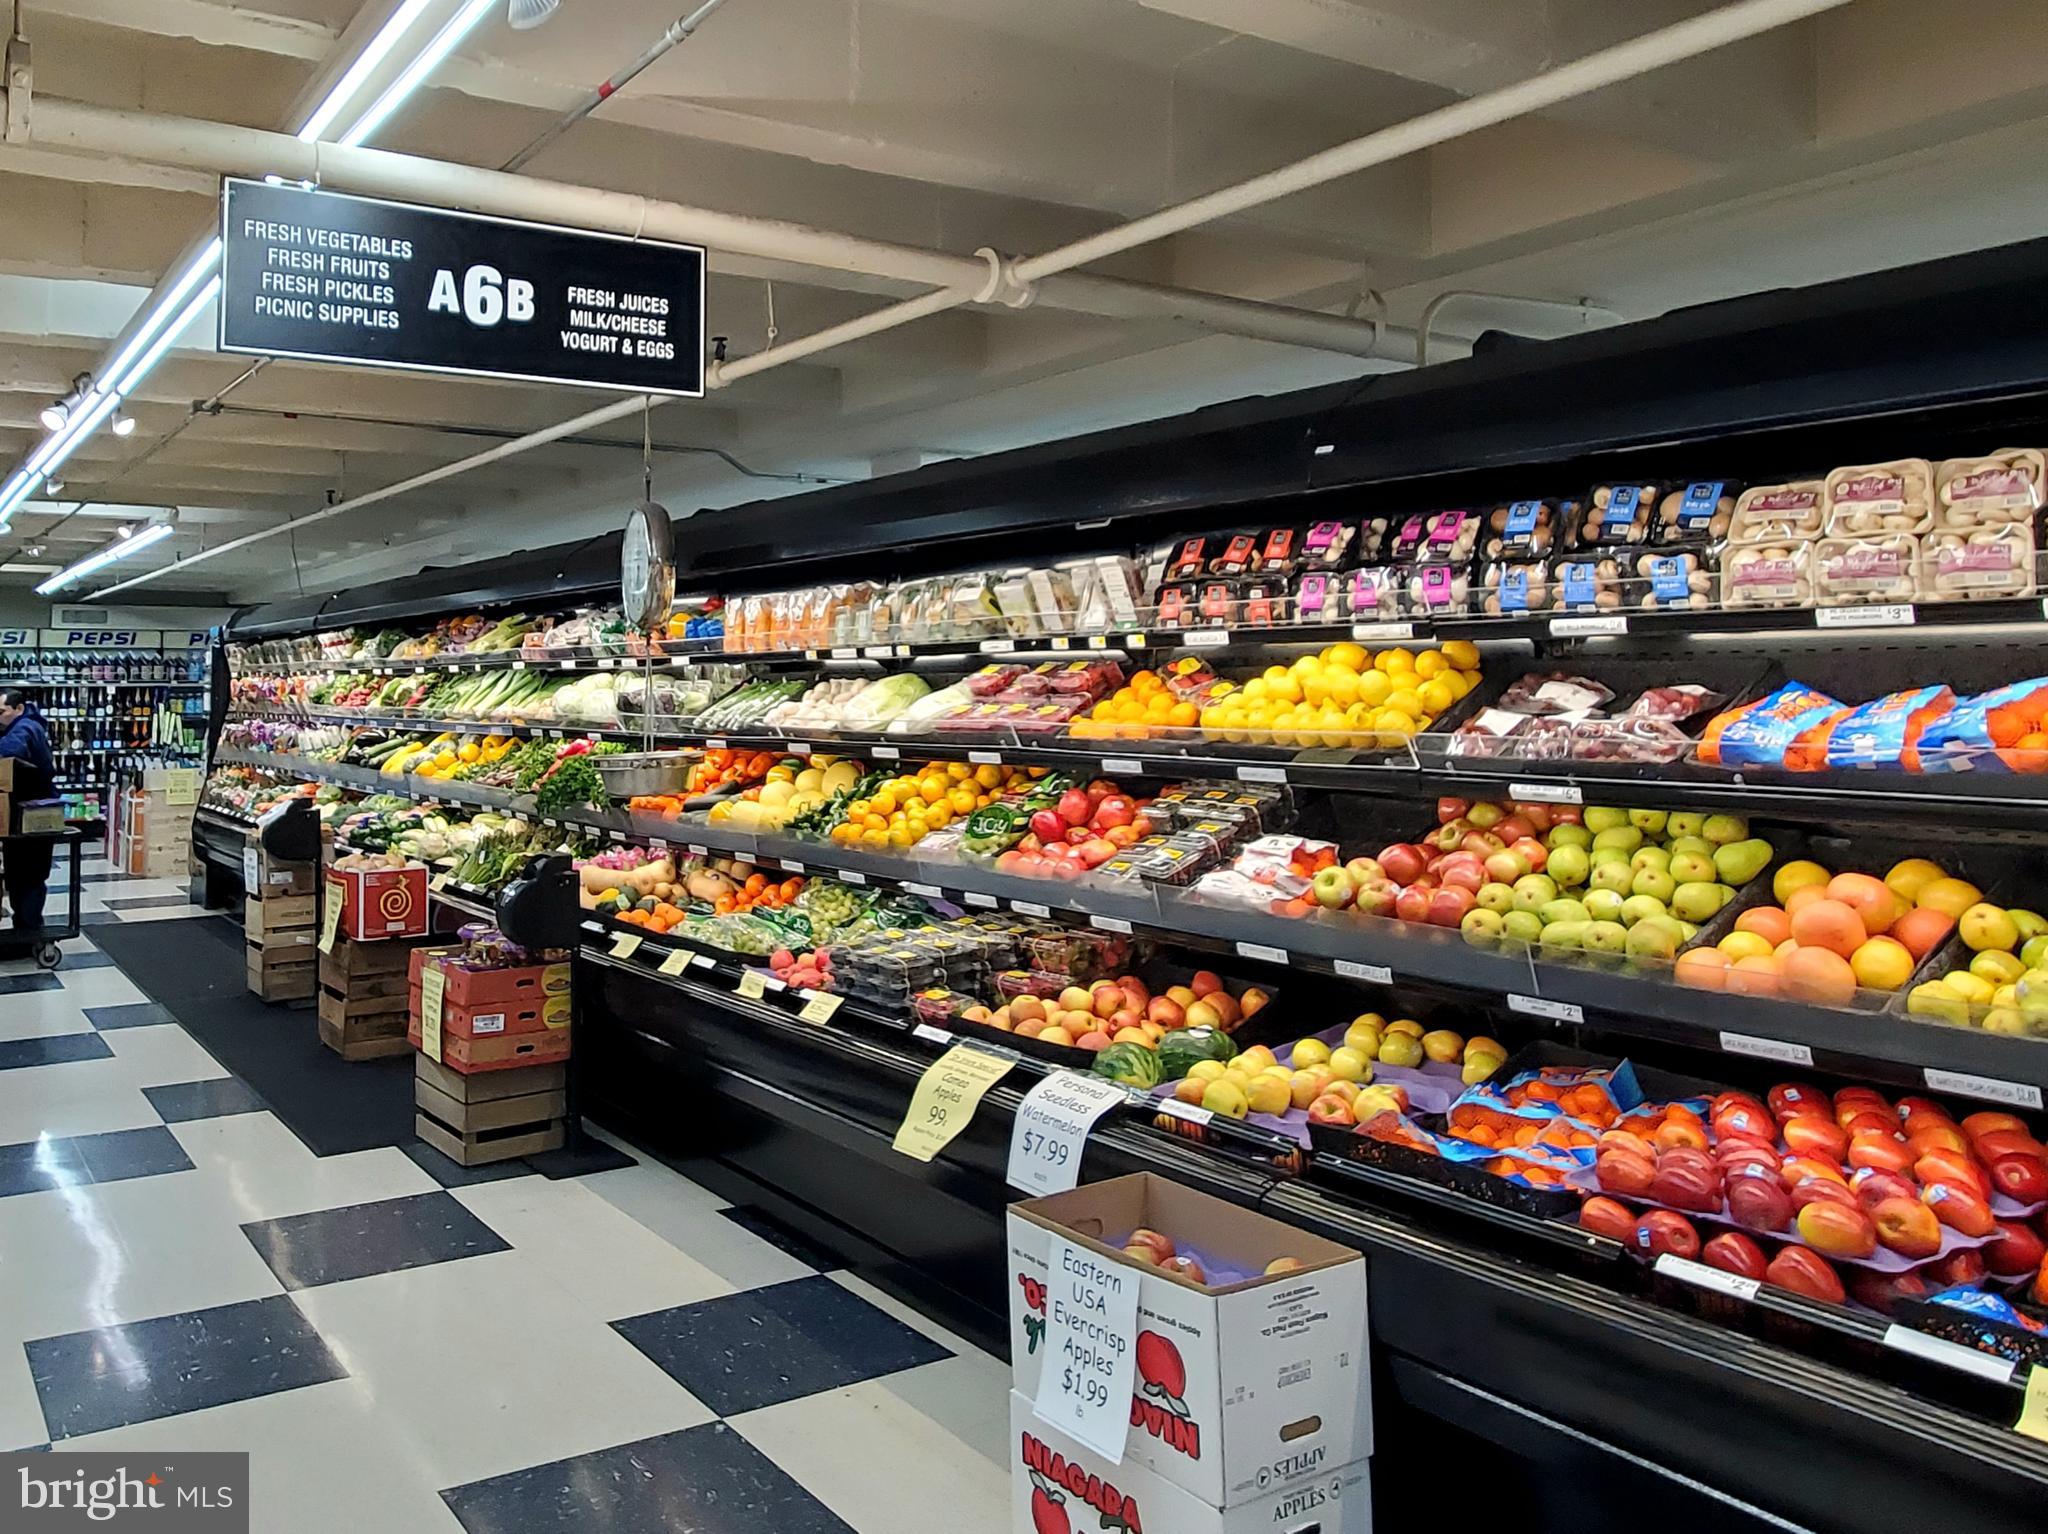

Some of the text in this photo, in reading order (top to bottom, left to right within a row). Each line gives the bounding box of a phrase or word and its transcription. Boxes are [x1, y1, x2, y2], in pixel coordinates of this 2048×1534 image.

[244, 219, 413, 259] FRESH VEGETABLES
[268, 248, 390, 279] FRESH FRUITS
[262, 272, 394, 304] FRESH PICKLES
[567, 285, 669, 315] FRESH JUICES
[255, 296, 400, 329] PICNIC SUPPLIES
[569, 309, 667, 337] MILK/CHEESE
[560, 330, 675, 360] YOGURT & EGGS
[67, 632, 137, 645] PEPSI
[933, 1085, 962, 1103] Apples
[1039, 1089, 1091, 1115] Seedless
[1056, 1075, 1110, 1100] Personal
[1022, 1103, 1083, 1137] Watermelon
[1022, 1128, 1069, 1166] $7.99
[1063, 1248, 1122, 1294] Eastern
[1073, 1281, 1107, 1316] USA
[1054, 1300, 1126, 1357] Evercrisp
[1063, 1337, 1114, 1376] Apples
[1062, 1365, 1108, 1407] $1.99
[1273, 1445, 1326, 1479] APPLES
[1022, 1430, 1142, 1534] NIAGARA
[1273, 1488, 1326, 1522] APPLES
